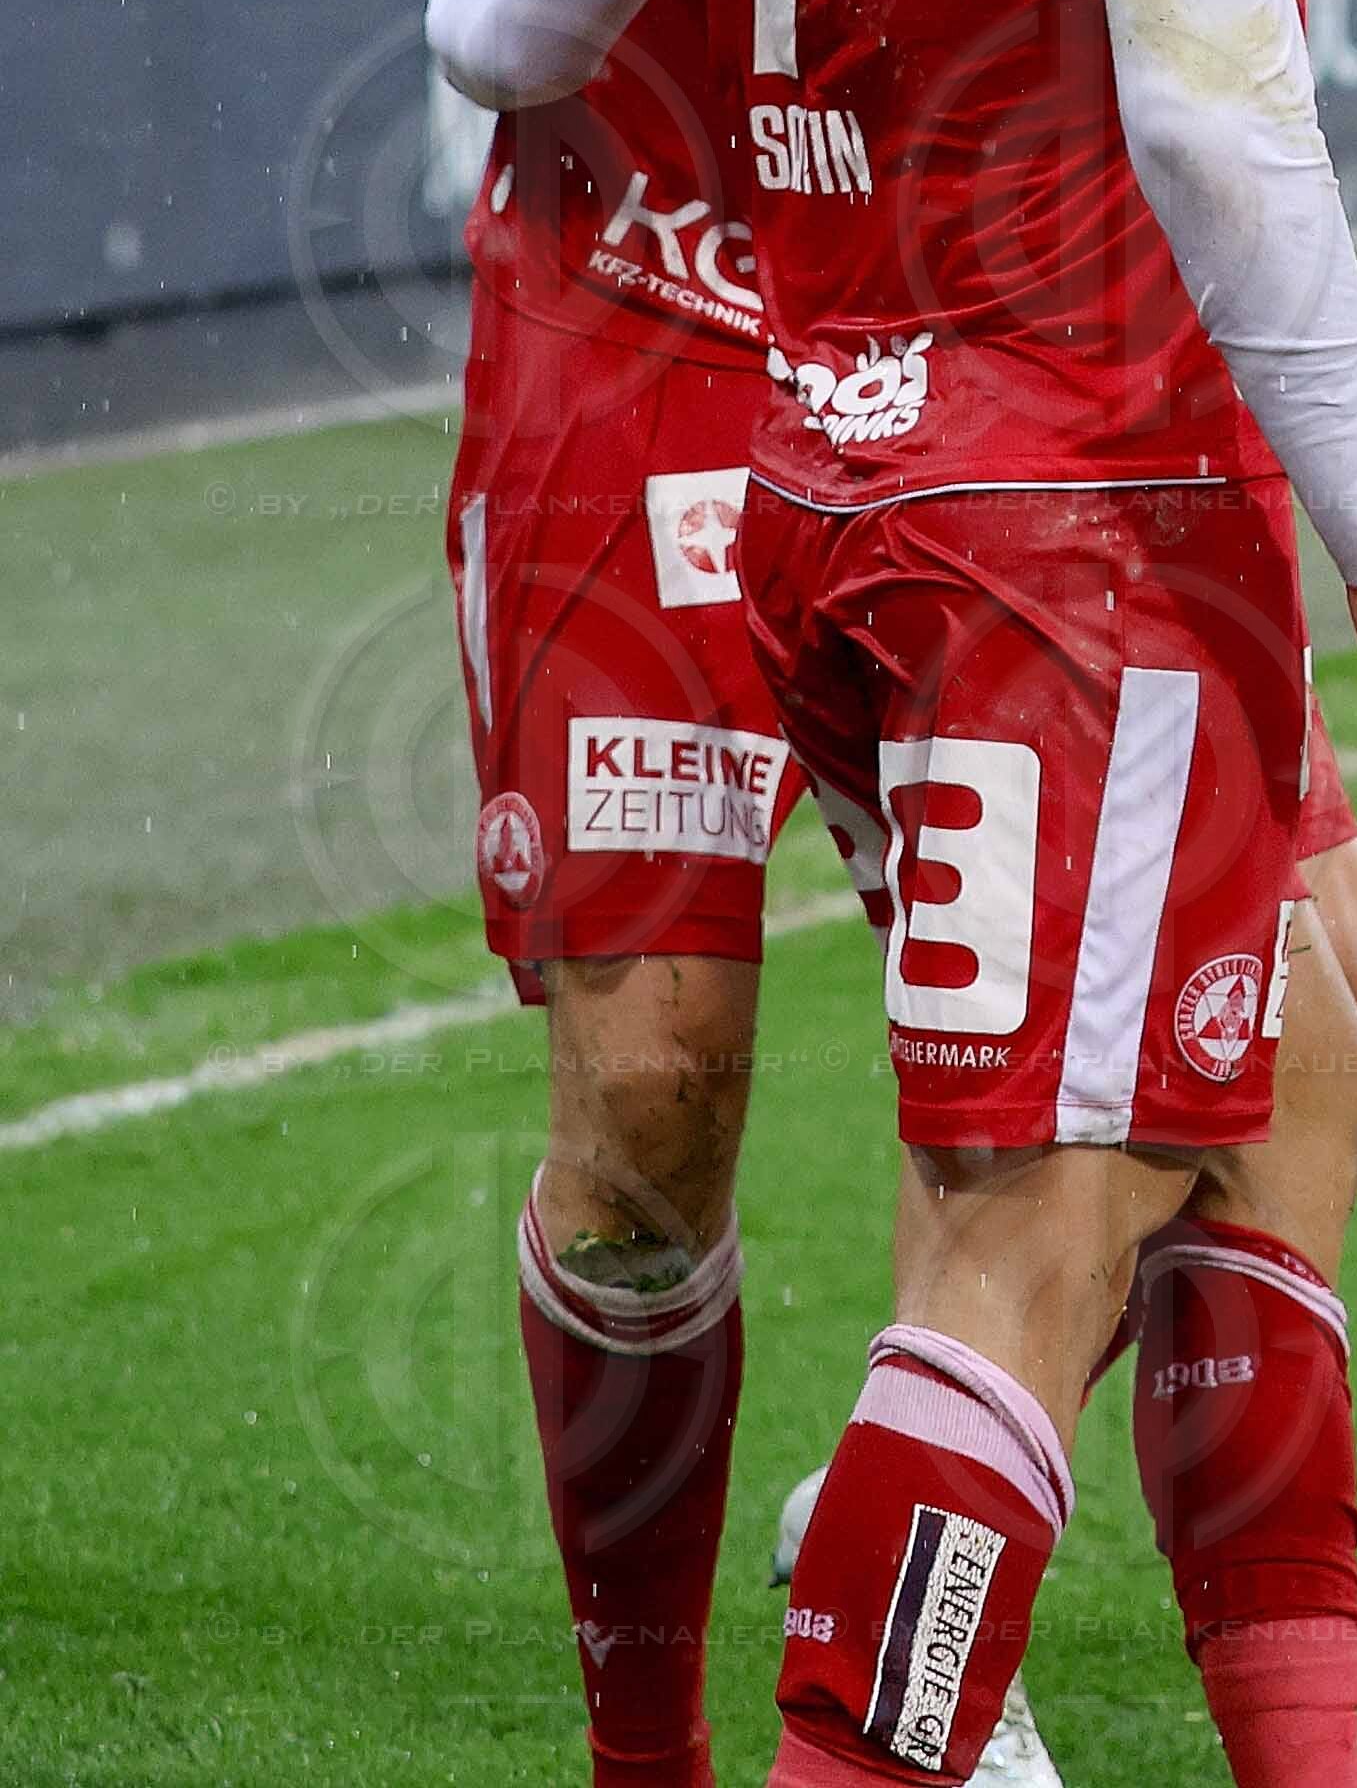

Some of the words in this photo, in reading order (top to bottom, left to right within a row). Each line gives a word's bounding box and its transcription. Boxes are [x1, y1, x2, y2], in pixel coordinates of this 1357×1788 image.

[587, 248, 764, 338] KFZ-TECHNIK
[585, 735, 773, 796] KLEINE
[585, 788, 768, 847] ZEITUNG
[922, 1551, 986, 1705] ENERGIE
